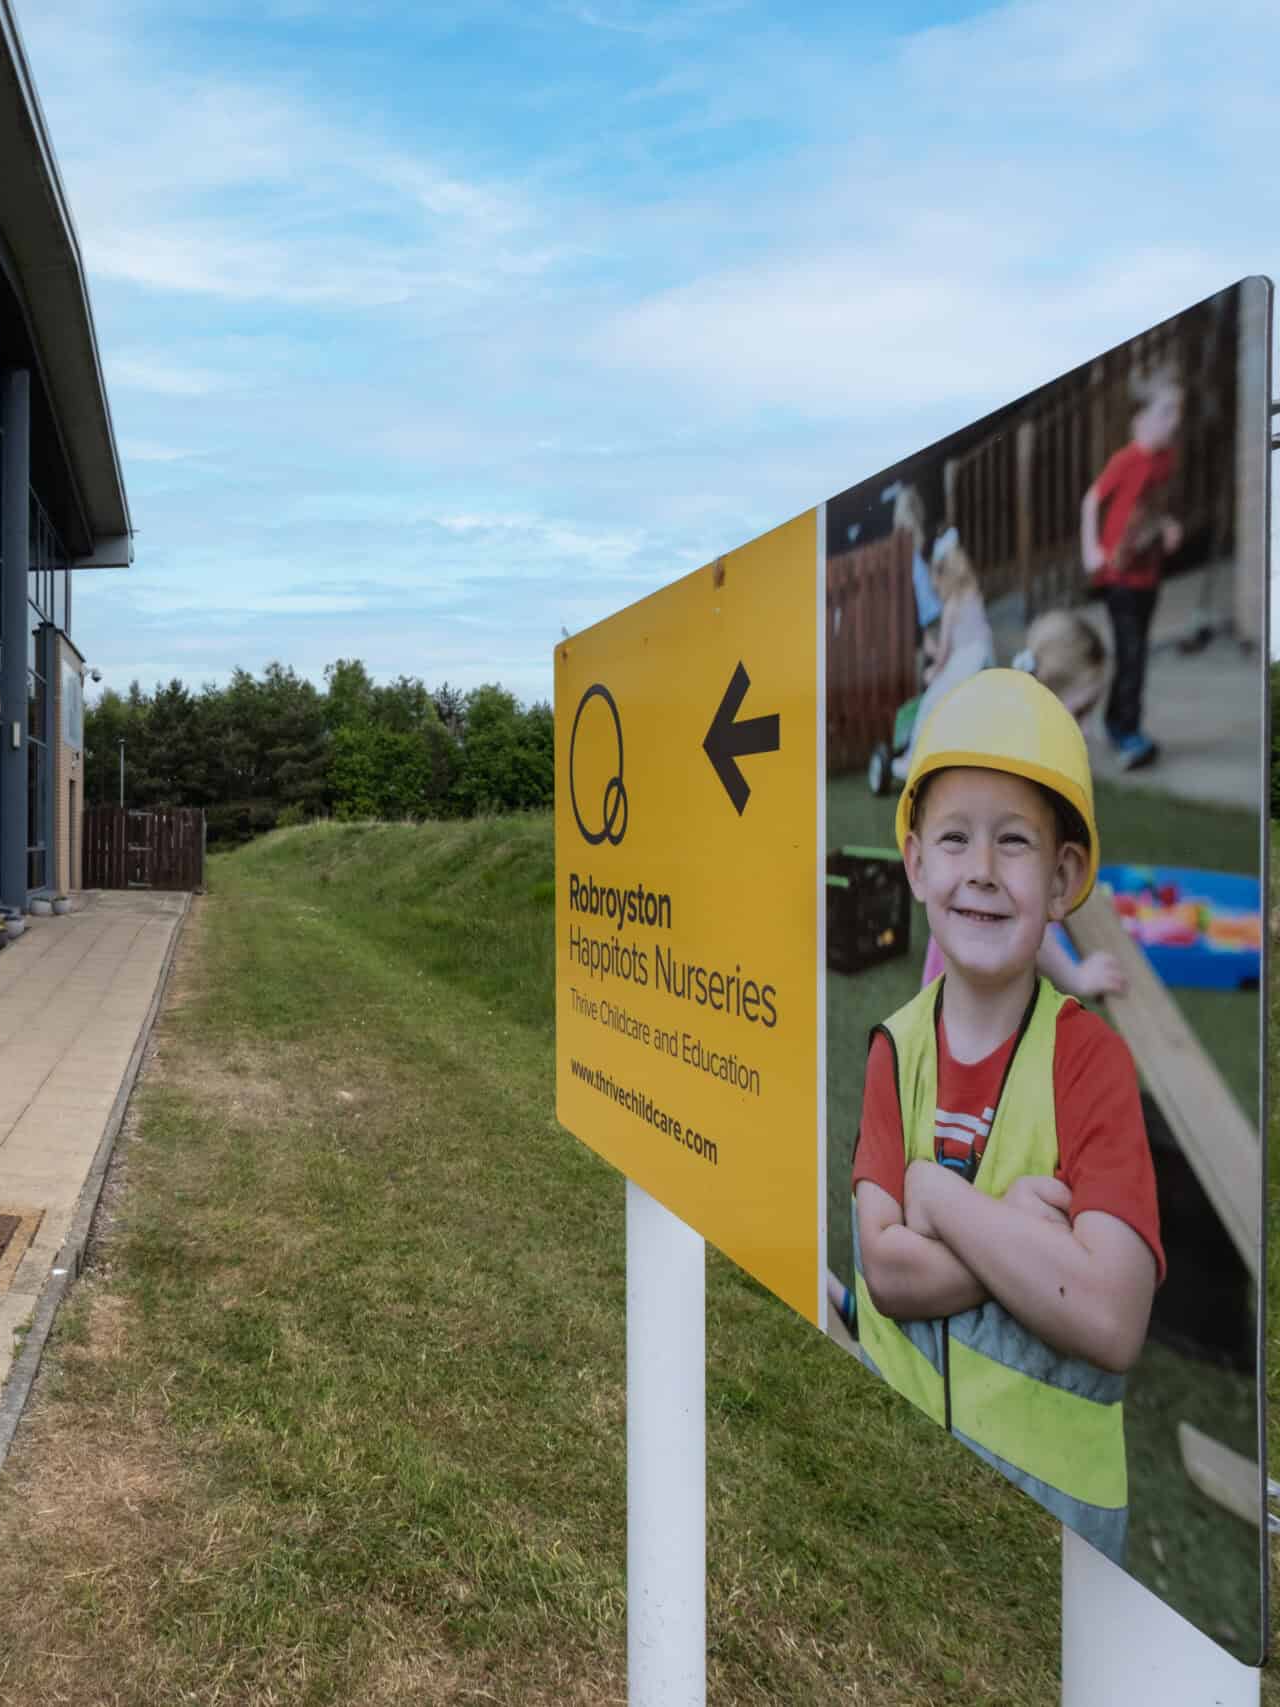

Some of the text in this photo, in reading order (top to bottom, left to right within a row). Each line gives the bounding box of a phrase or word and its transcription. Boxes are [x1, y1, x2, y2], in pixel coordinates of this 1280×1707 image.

[570, 873, 671, 930] Robroyston
[570, 924, 777, 1028] Happitots Nurseries
[571, 987, 760, 1097] Thrive Childcare and Education
[571, 1057, 718, 1165] www.thrivechildcare.com
